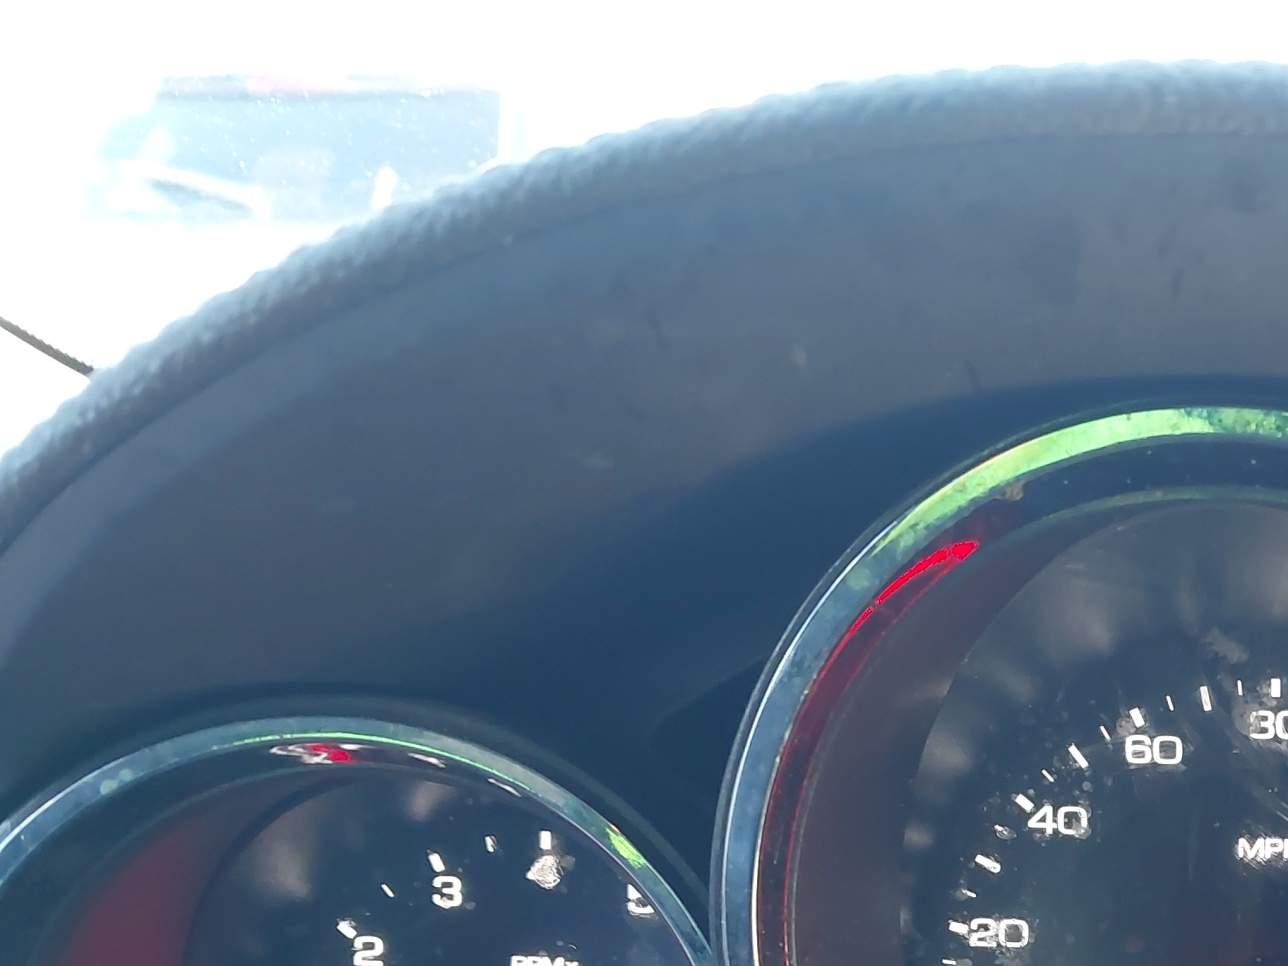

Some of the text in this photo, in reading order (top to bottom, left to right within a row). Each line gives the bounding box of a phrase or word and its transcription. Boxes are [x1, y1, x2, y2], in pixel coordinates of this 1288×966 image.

[1125, 735, 1183, 765] 60
[1028, 805, 1089, 835] 40
[432, 875, 462, 908] 3
[968, 917, 1030, 948] 20
